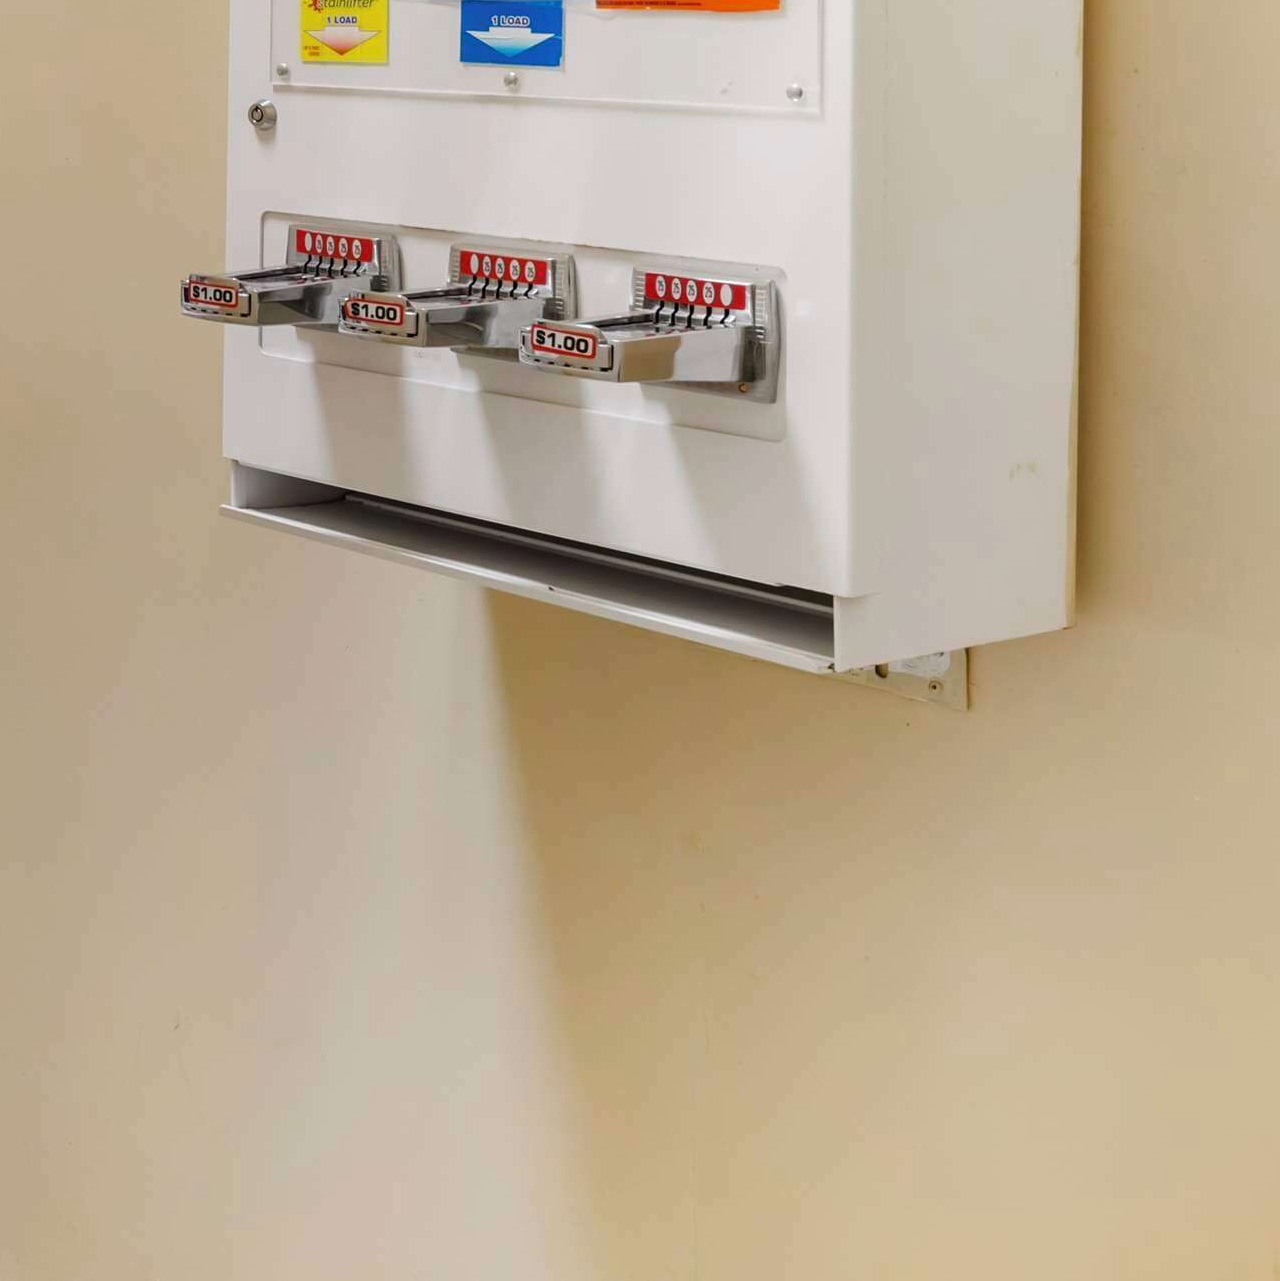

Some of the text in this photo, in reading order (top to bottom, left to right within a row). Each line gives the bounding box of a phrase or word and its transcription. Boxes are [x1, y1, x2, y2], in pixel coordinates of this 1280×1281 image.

[334, 16, 357, 24] LOAD
[491, 15, 530, 27] 1 LOAD
[192, 284, 233, 303] $1.00
[704, 286, 713, 298] 25
[350, 302, 398, 321] $1.00
[535, 329, 589, 354] $1.00
